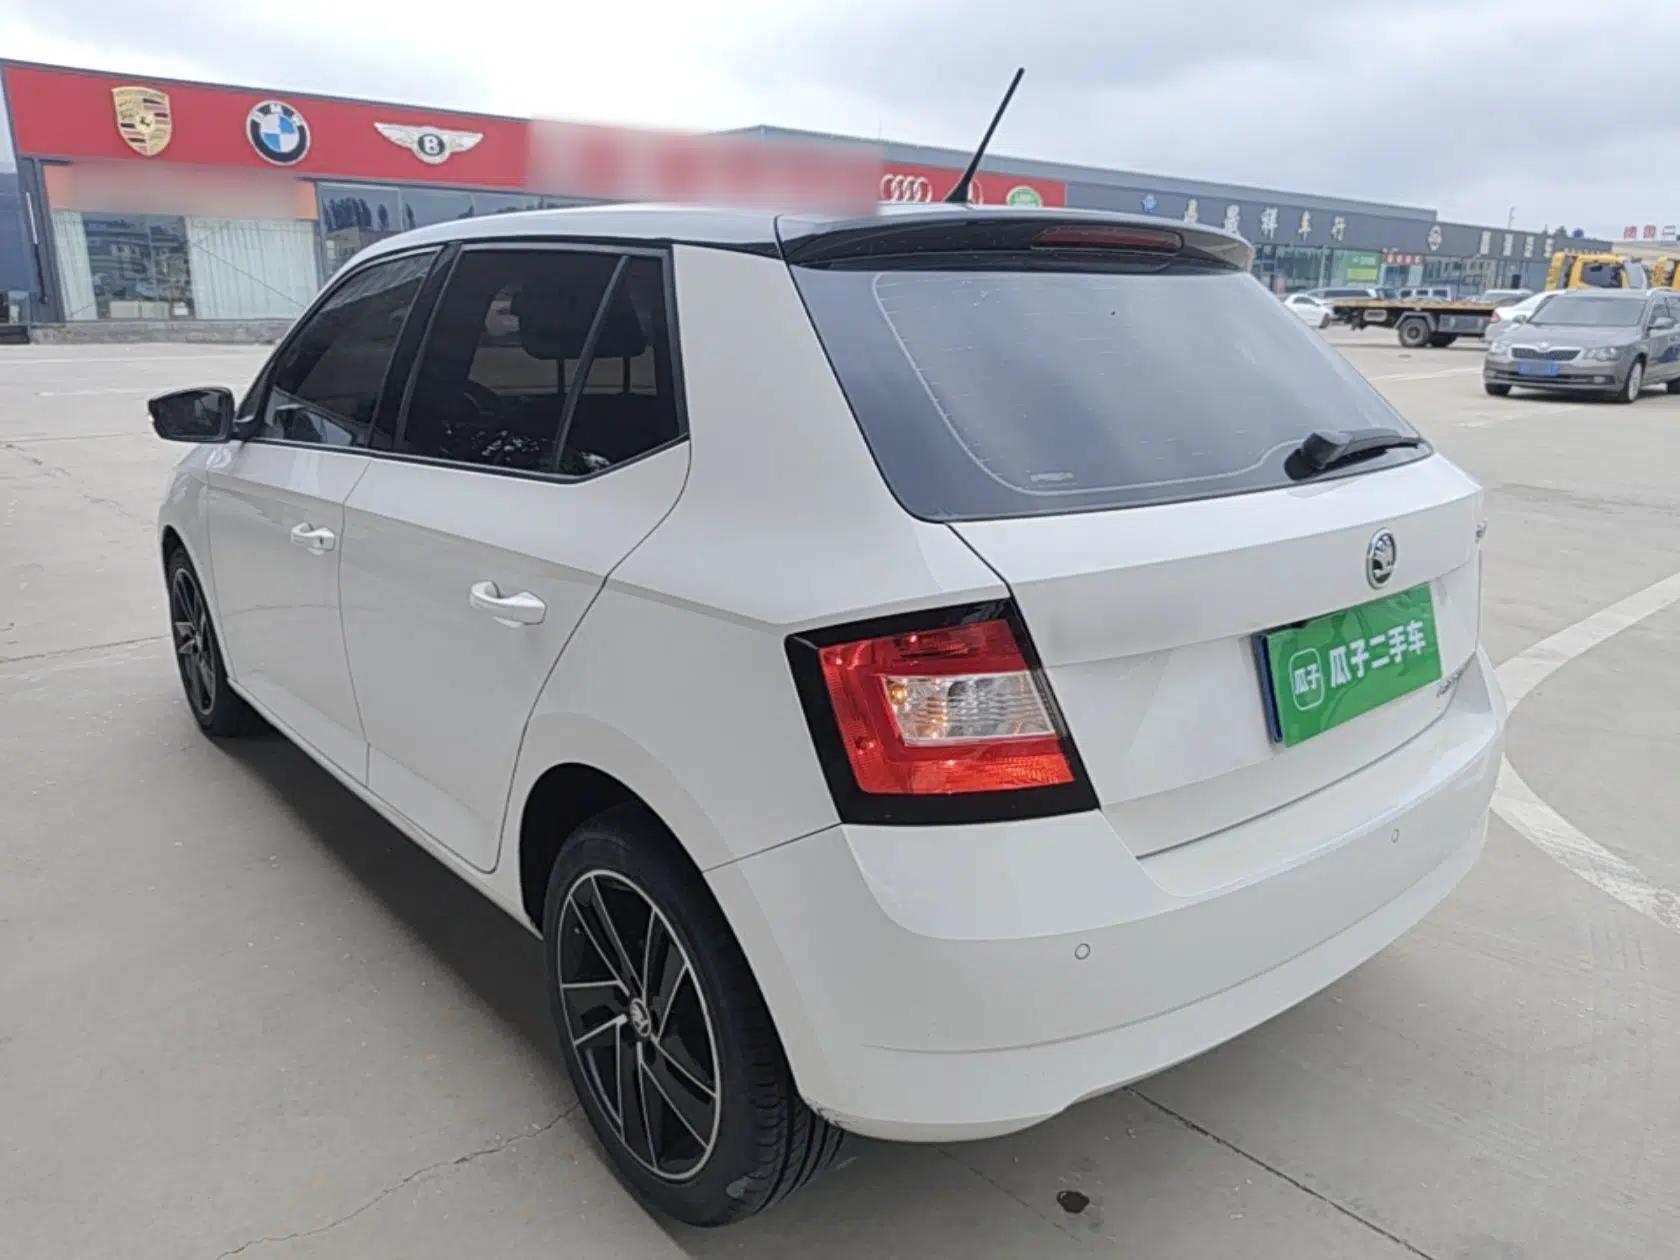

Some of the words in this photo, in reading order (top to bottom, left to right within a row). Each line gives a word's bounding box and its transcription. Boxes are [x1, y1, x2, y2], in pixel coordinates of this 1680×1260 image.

[1329, 620, 1427, 688] 瓜子二手车
[1293, 664, 1321, 695] 瓜子
